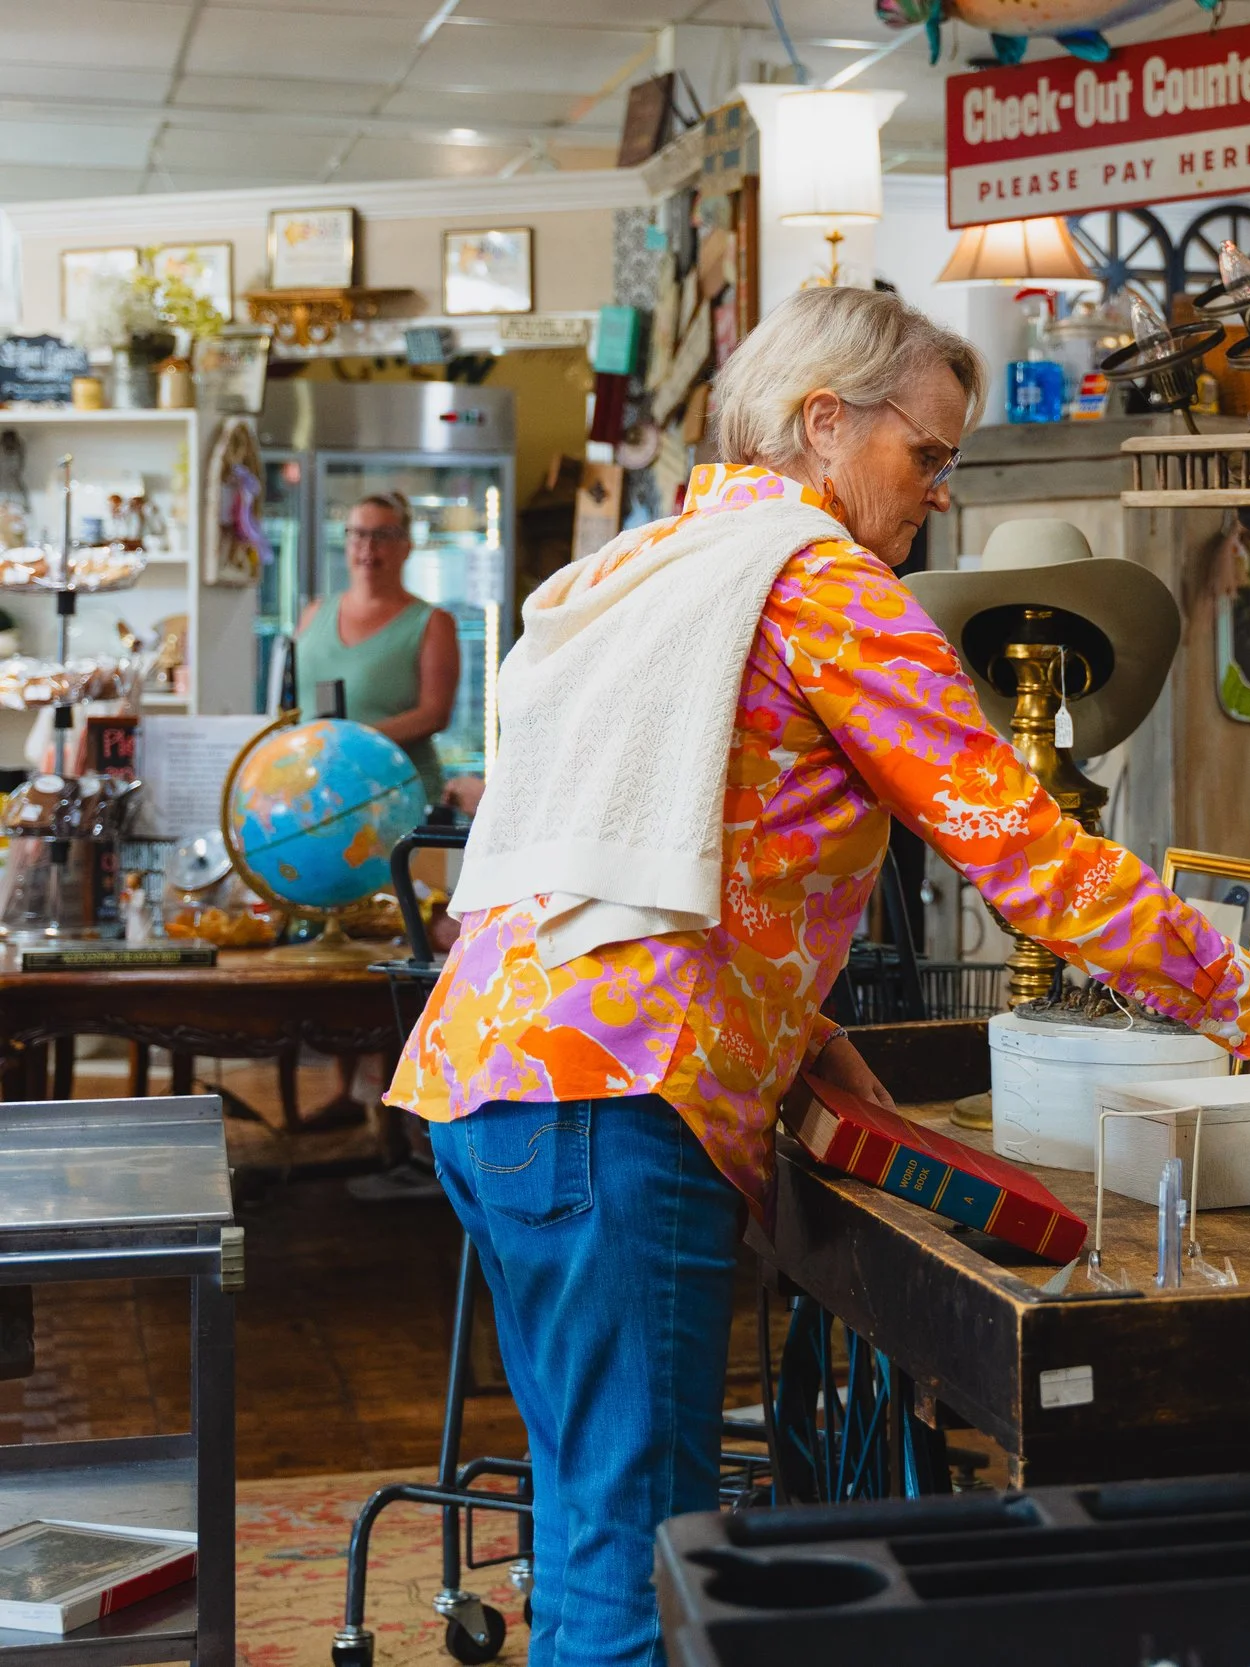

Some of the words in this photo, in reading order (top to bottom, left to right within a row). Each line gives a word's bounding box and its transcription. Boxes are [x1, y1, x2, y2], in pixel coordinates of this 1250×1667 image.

[963, 69, 1132, 146] Check-Out
[978, 169, 1079, 202] PLEASE
[1103, 157, 1155, 186] PAY
[900, 1159, 918, 1188] WORLD
[914, 1168, 930, 1191] BOOK
[963, 1196, 974, 1205] A
